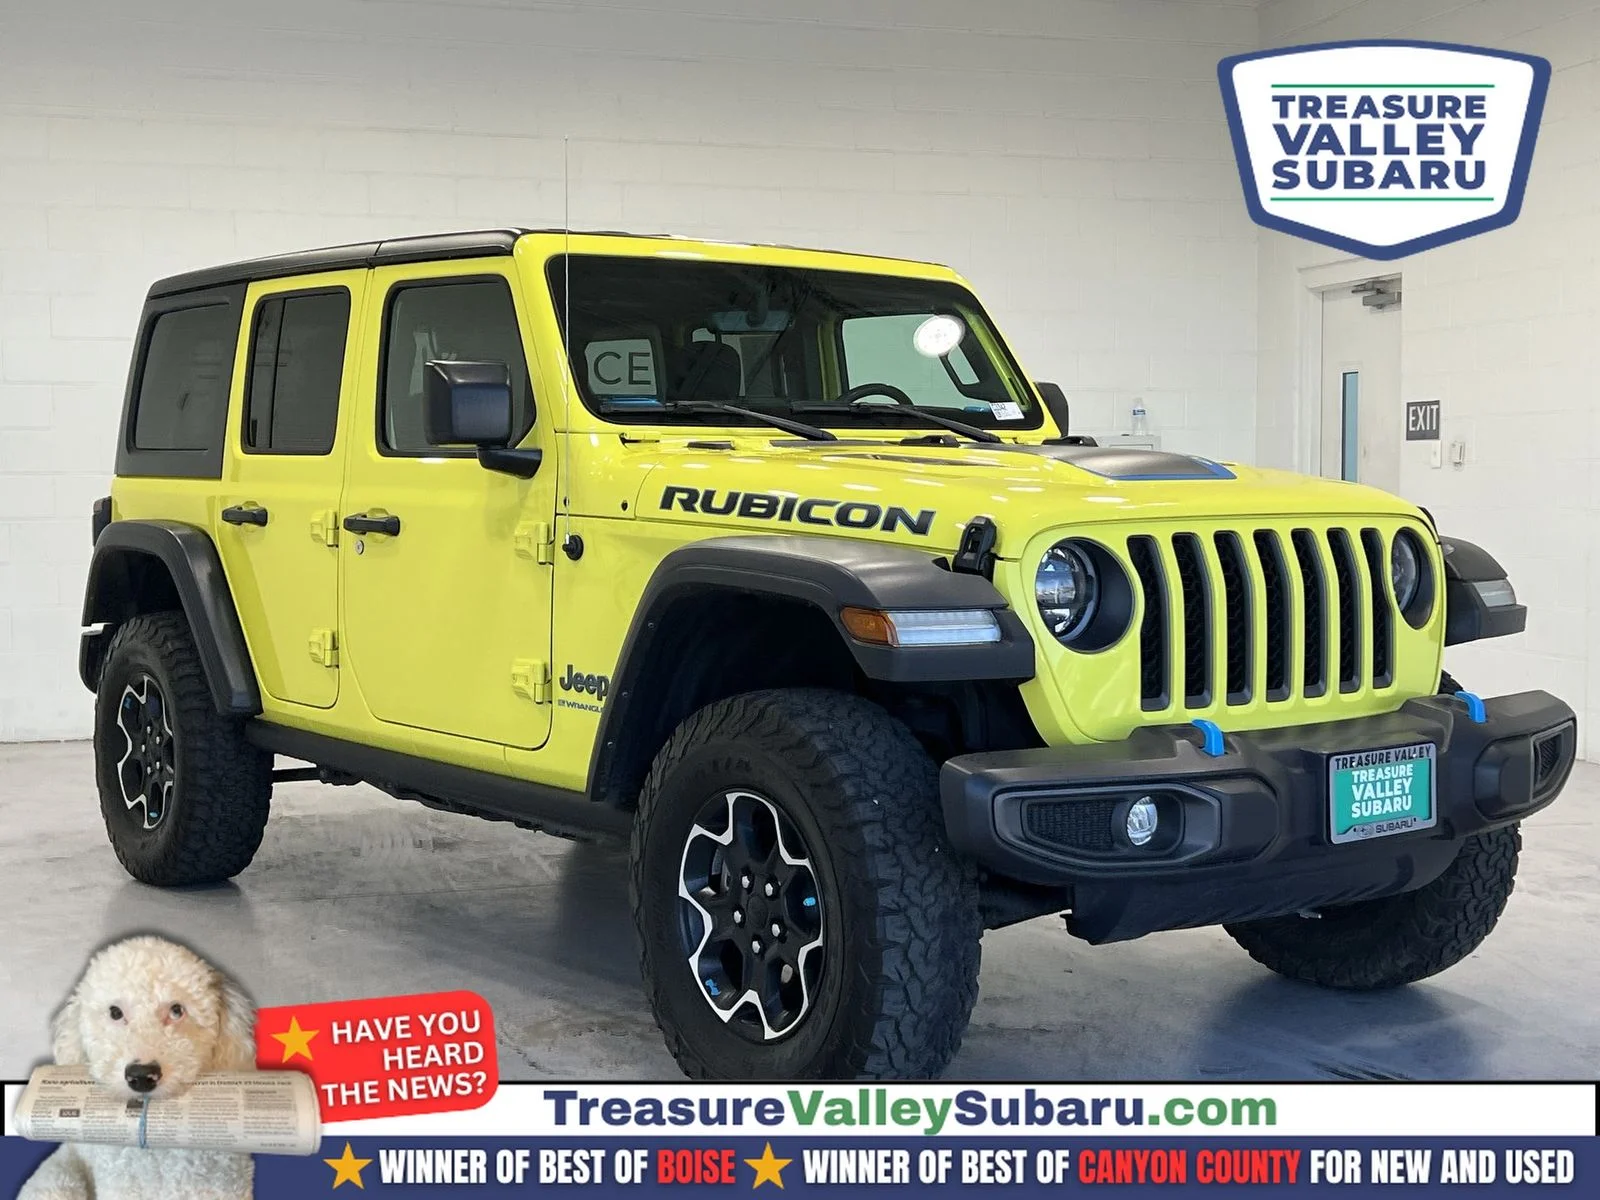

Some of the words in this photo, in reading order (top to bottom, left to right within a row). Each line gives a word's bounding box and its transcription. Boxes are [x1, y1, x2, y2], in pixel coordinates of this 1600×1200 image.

[1408, 404, 1439, 431] EXIT
[659, 485, 936, 536] RUBICON
[559, 664, 609, 701] Jeep
[1335, 751, 1391, 770] TREASURE
[1394, 745, 1432, 762] VALLEY
[1351, 763, 1414, 783] TREASURE
[1351, 777, 1413, 801] VALLEY
[1351, 795, 1412, 818] SUBARU
[1375, 819, 1413, 833] SUBARU
